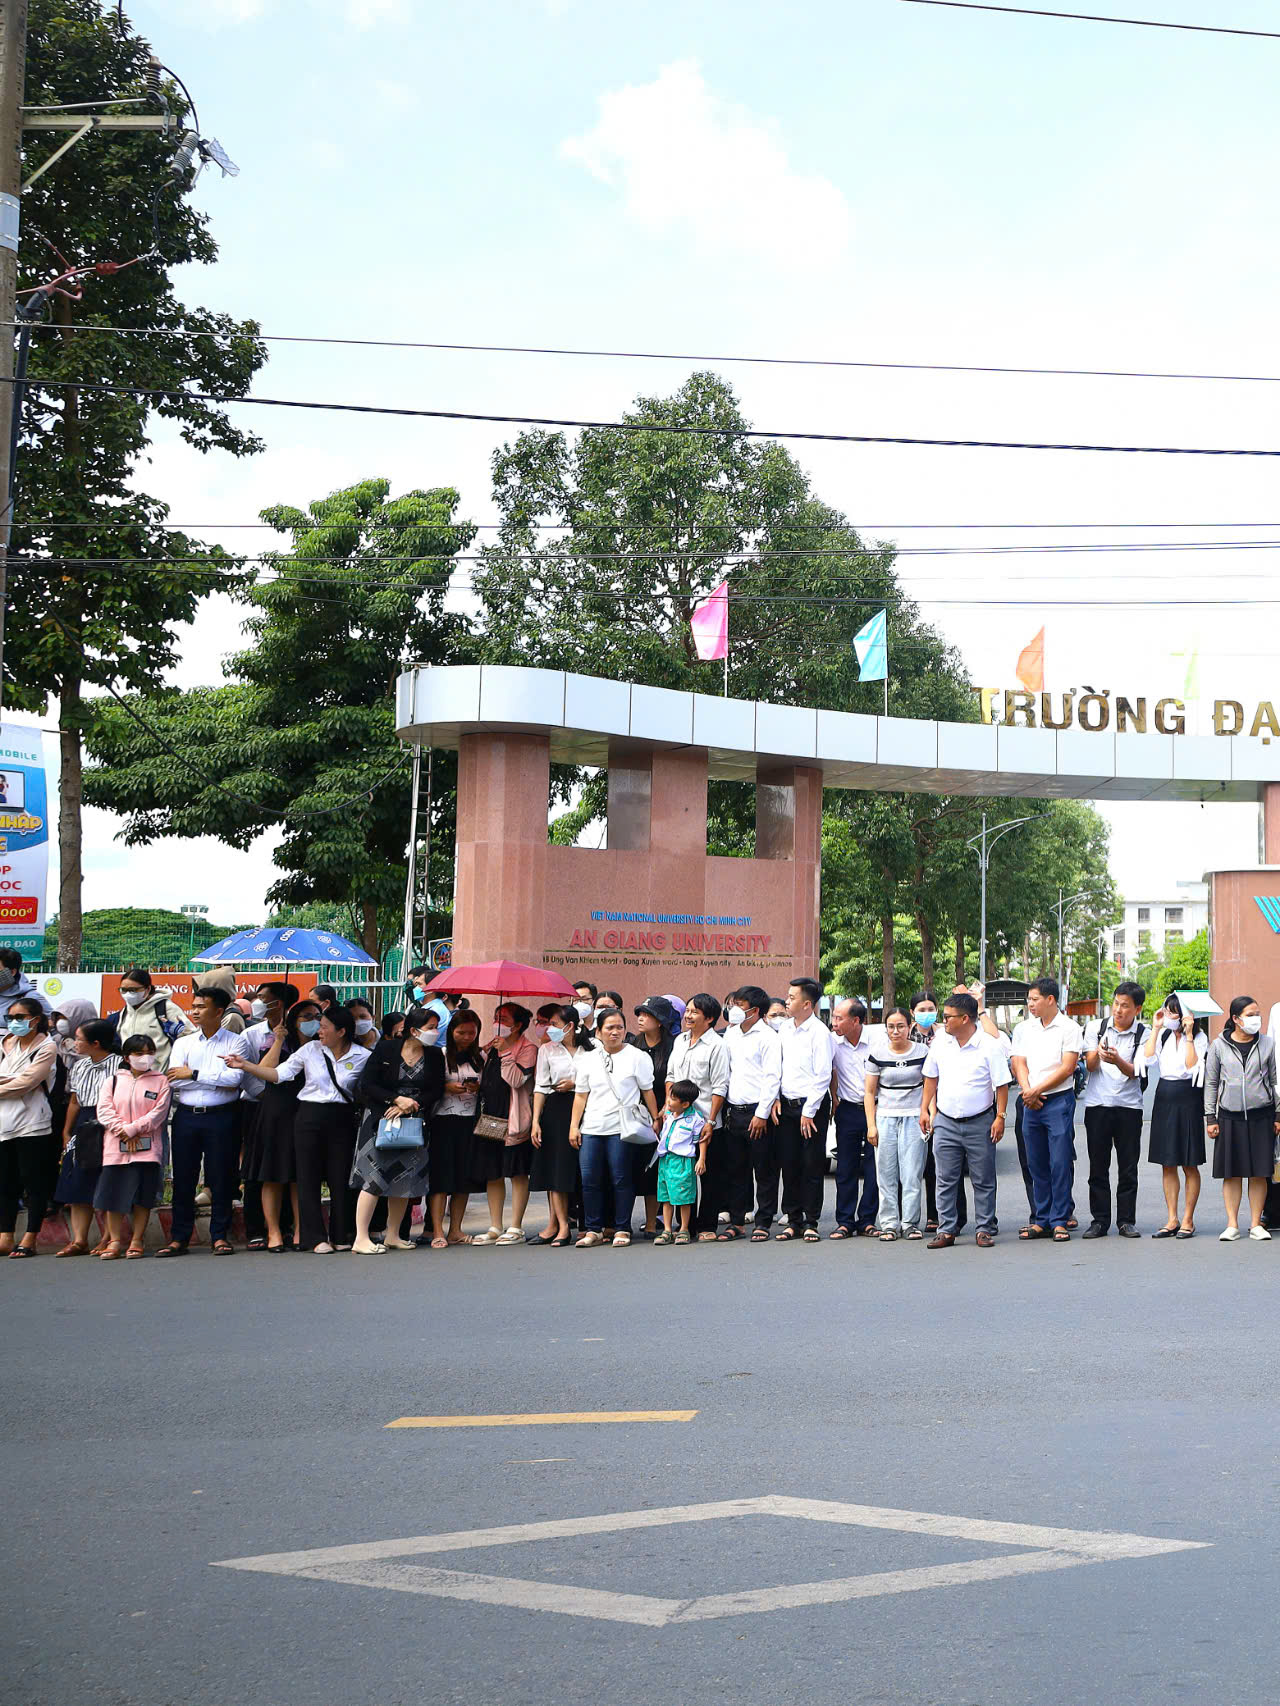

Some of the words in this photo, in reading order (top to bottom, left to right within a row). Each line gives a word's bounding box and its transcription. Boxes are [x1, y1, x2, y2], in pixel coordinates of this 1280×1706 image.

[969, 685, 1186, 735] TRƯỜNG
[591, 910, 605, 920] VIET
[606, 911, 623, 921] NAM
[623, 912, 657, 923] NATIONAL
[658, 913, 694, 924] UNIVERSITY
[719, 915, 737, 926] MINH
[737, 916, 752, 926] CITY
[569, 928, 599, 948] AN
[603, 929, 667, 950] GIANG
[672, 932, 771, 953] UNIVERSITY
[551, 956, 564, 965] Ung
[565, 956, 578, 964] Van
[683, 959, 698, 968] Long
[699, 959, 718, 968] Xuyen
[719, 959, 732, 968] city
